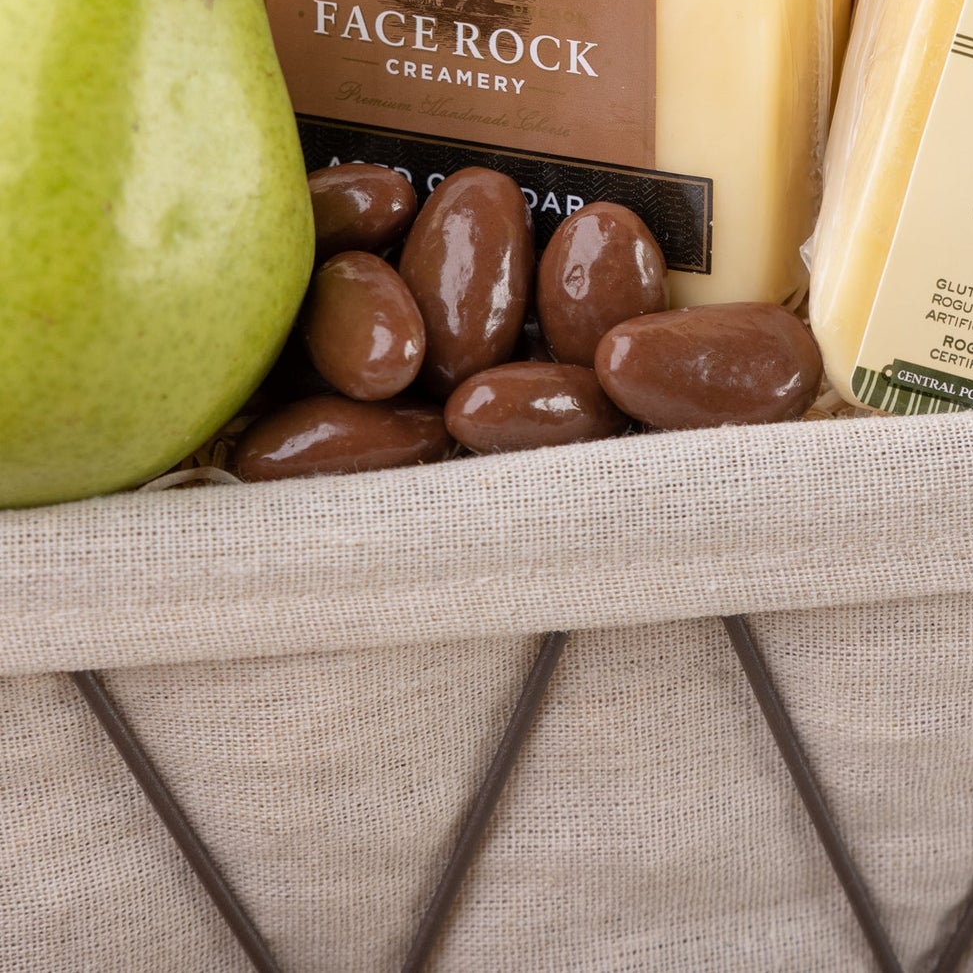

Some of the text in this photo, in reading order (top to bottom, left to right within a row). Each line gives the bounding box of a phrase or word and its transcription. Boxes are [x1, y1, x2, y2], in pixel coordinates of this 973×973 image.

[313, 0, 599, 77] FACE ROCK
[385, 59, 526, 95] CREAMERY
[335, 81, 413, 113] Premium
[418, 94, 510, 128] Handmade
[426, 173, 585, 215] CDAR
[897, 369, 956, 397] CENTRAL
